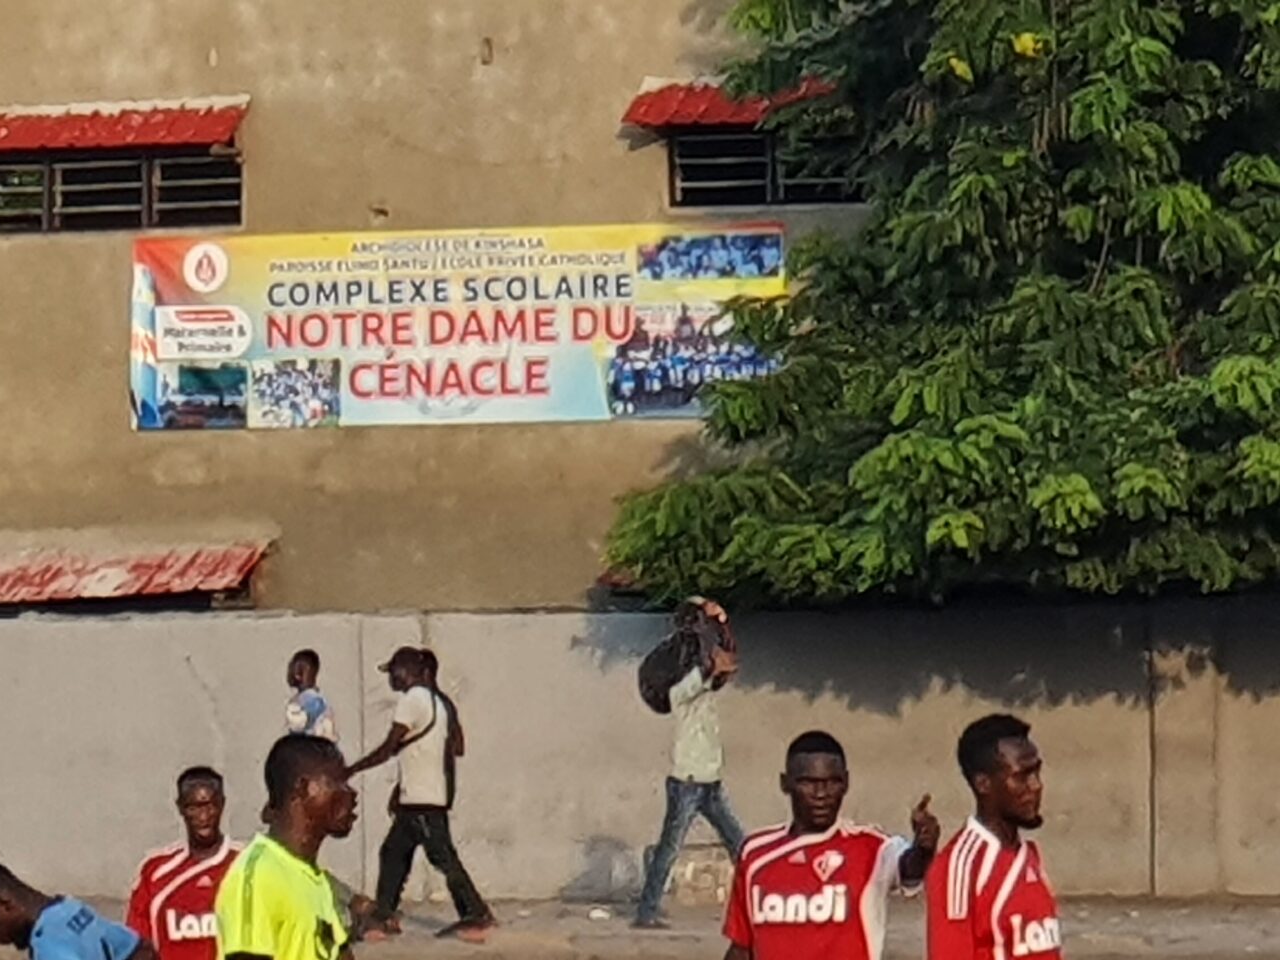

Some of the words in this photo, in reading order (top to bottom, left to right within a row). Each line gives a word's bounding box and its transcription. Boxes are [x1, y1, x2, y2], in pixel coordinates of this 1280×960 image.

[473, 237, 546, 250] KINSHASA
[269, 260, 333, 273] PAROISSE
[381, 257, 429, 271] SANTU
[538, 252, 627, 267] CATHOLIQUE
[267, 278, 450, 307] COMPLEXE
[462, 273, 633, 300] SCOLAIRE
[266, 309, 413, 347] NOTRE
[428, 308, 557, 345] DAME
[572, 305, 633, 343] DU
[348, 350, 550, 398] CÉNACLE
[752, 884, 848, 923] Landi
